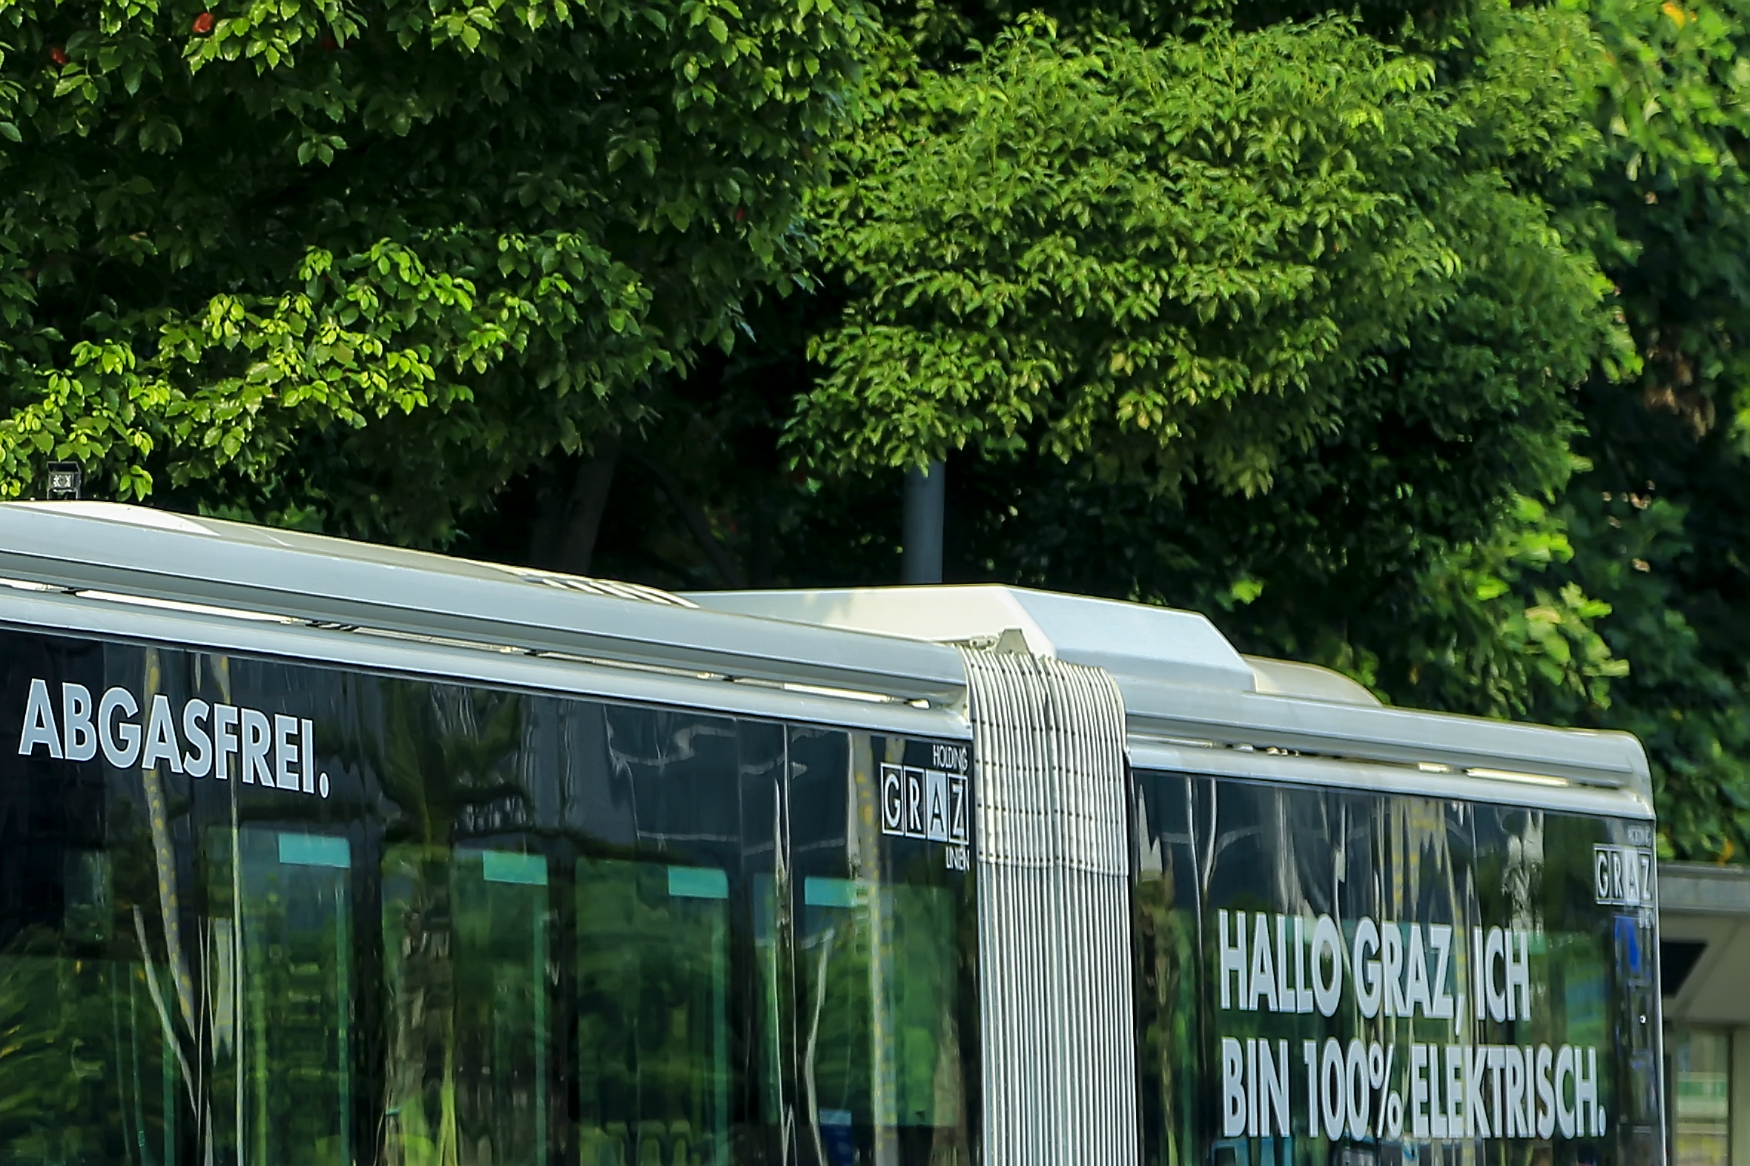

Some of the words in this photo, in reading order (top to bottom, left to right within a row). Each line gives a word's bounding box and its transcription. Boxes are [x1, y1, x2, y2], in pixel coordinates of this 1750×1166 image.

[18, 678, 330, 798] ABGASFREI.
[933, 745, 968, 771] HOLDING
[884, 773, 965, 837] GRAZ
[1218, 909, 1343, 1017] HALLO
[1353, 916, 1464, 1036] GRAZ,
[1473, 925, 1530, 1022] ICH
[1222, 1036, 1290, 1137] BIN
[1303, 1036, 1403, 1141] 100%
[1410, 1043, 1607, 1140] ELEKTRISCH.
